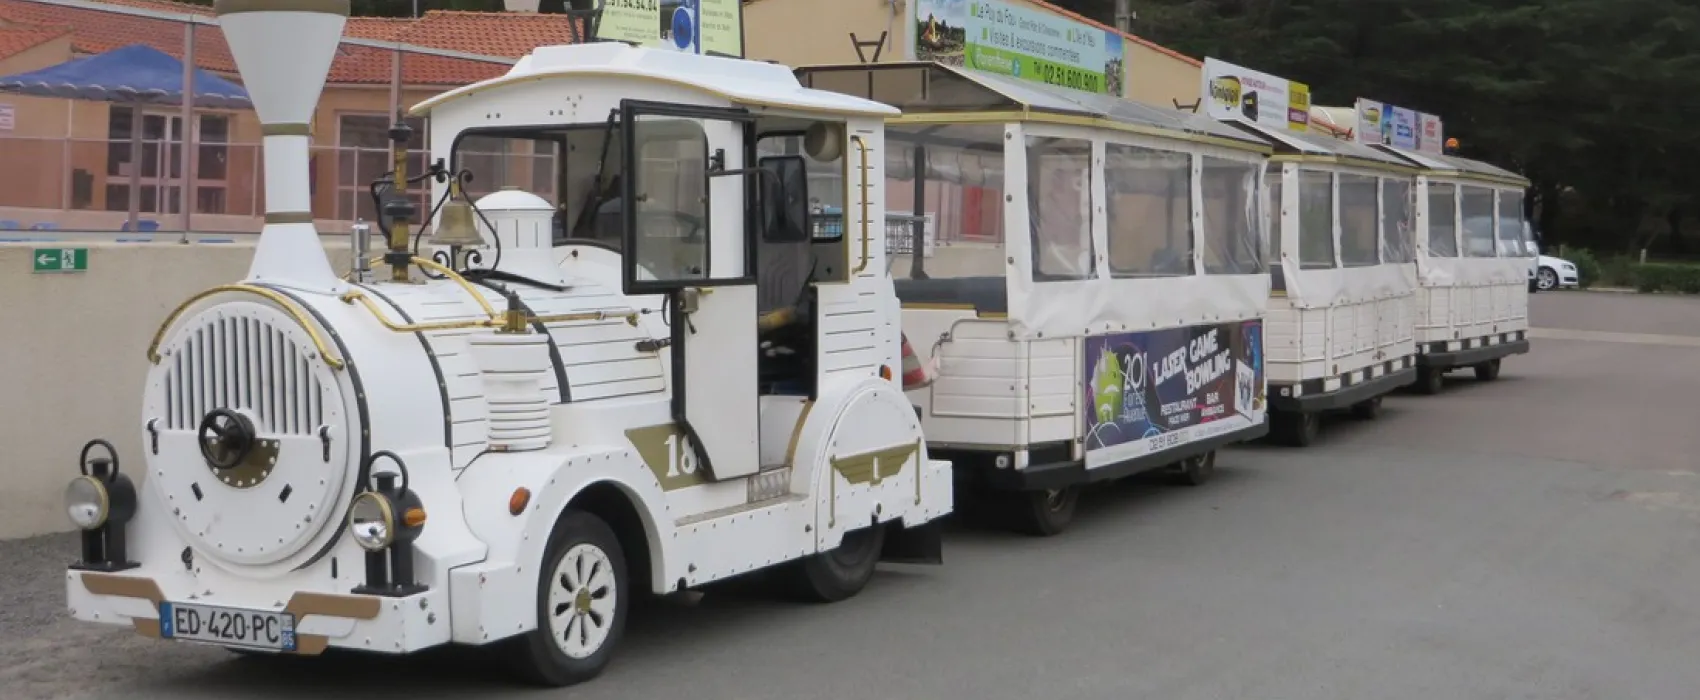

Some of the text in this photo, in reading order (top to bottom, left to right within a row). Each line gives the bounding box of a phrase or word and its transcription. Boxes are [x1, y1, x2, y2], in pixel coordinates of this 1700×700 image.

[1152, 327, 1219, 386] LASER GAME
[1185, 347, 1231, 395] BOWLING
[1160, 397, 1197, 417] RESTAURANT
